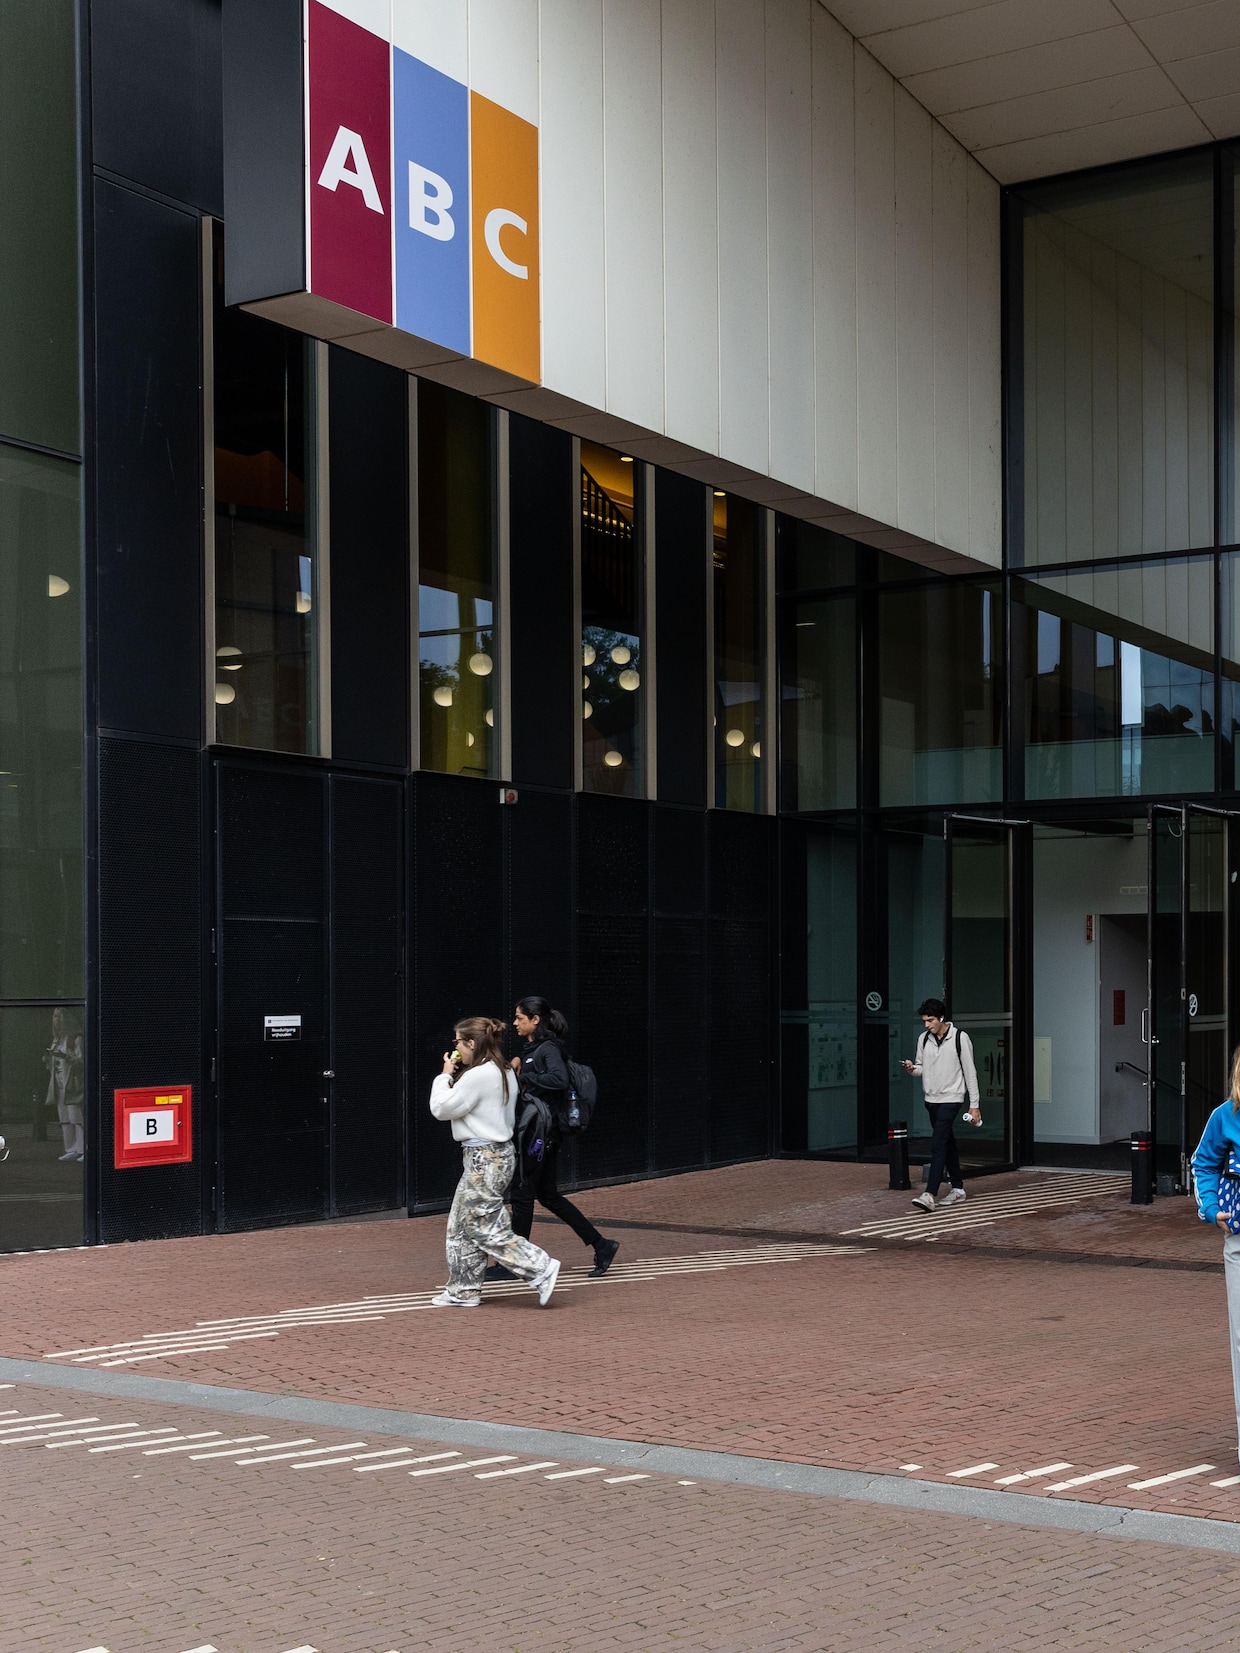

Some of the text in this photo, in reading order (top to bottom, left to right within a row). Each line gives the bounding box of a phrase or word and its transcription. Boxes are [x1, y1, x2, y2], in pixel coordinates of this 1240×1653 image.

[317, 125, 528, 280] A B C
[146, 1118, 158, 1136] B
